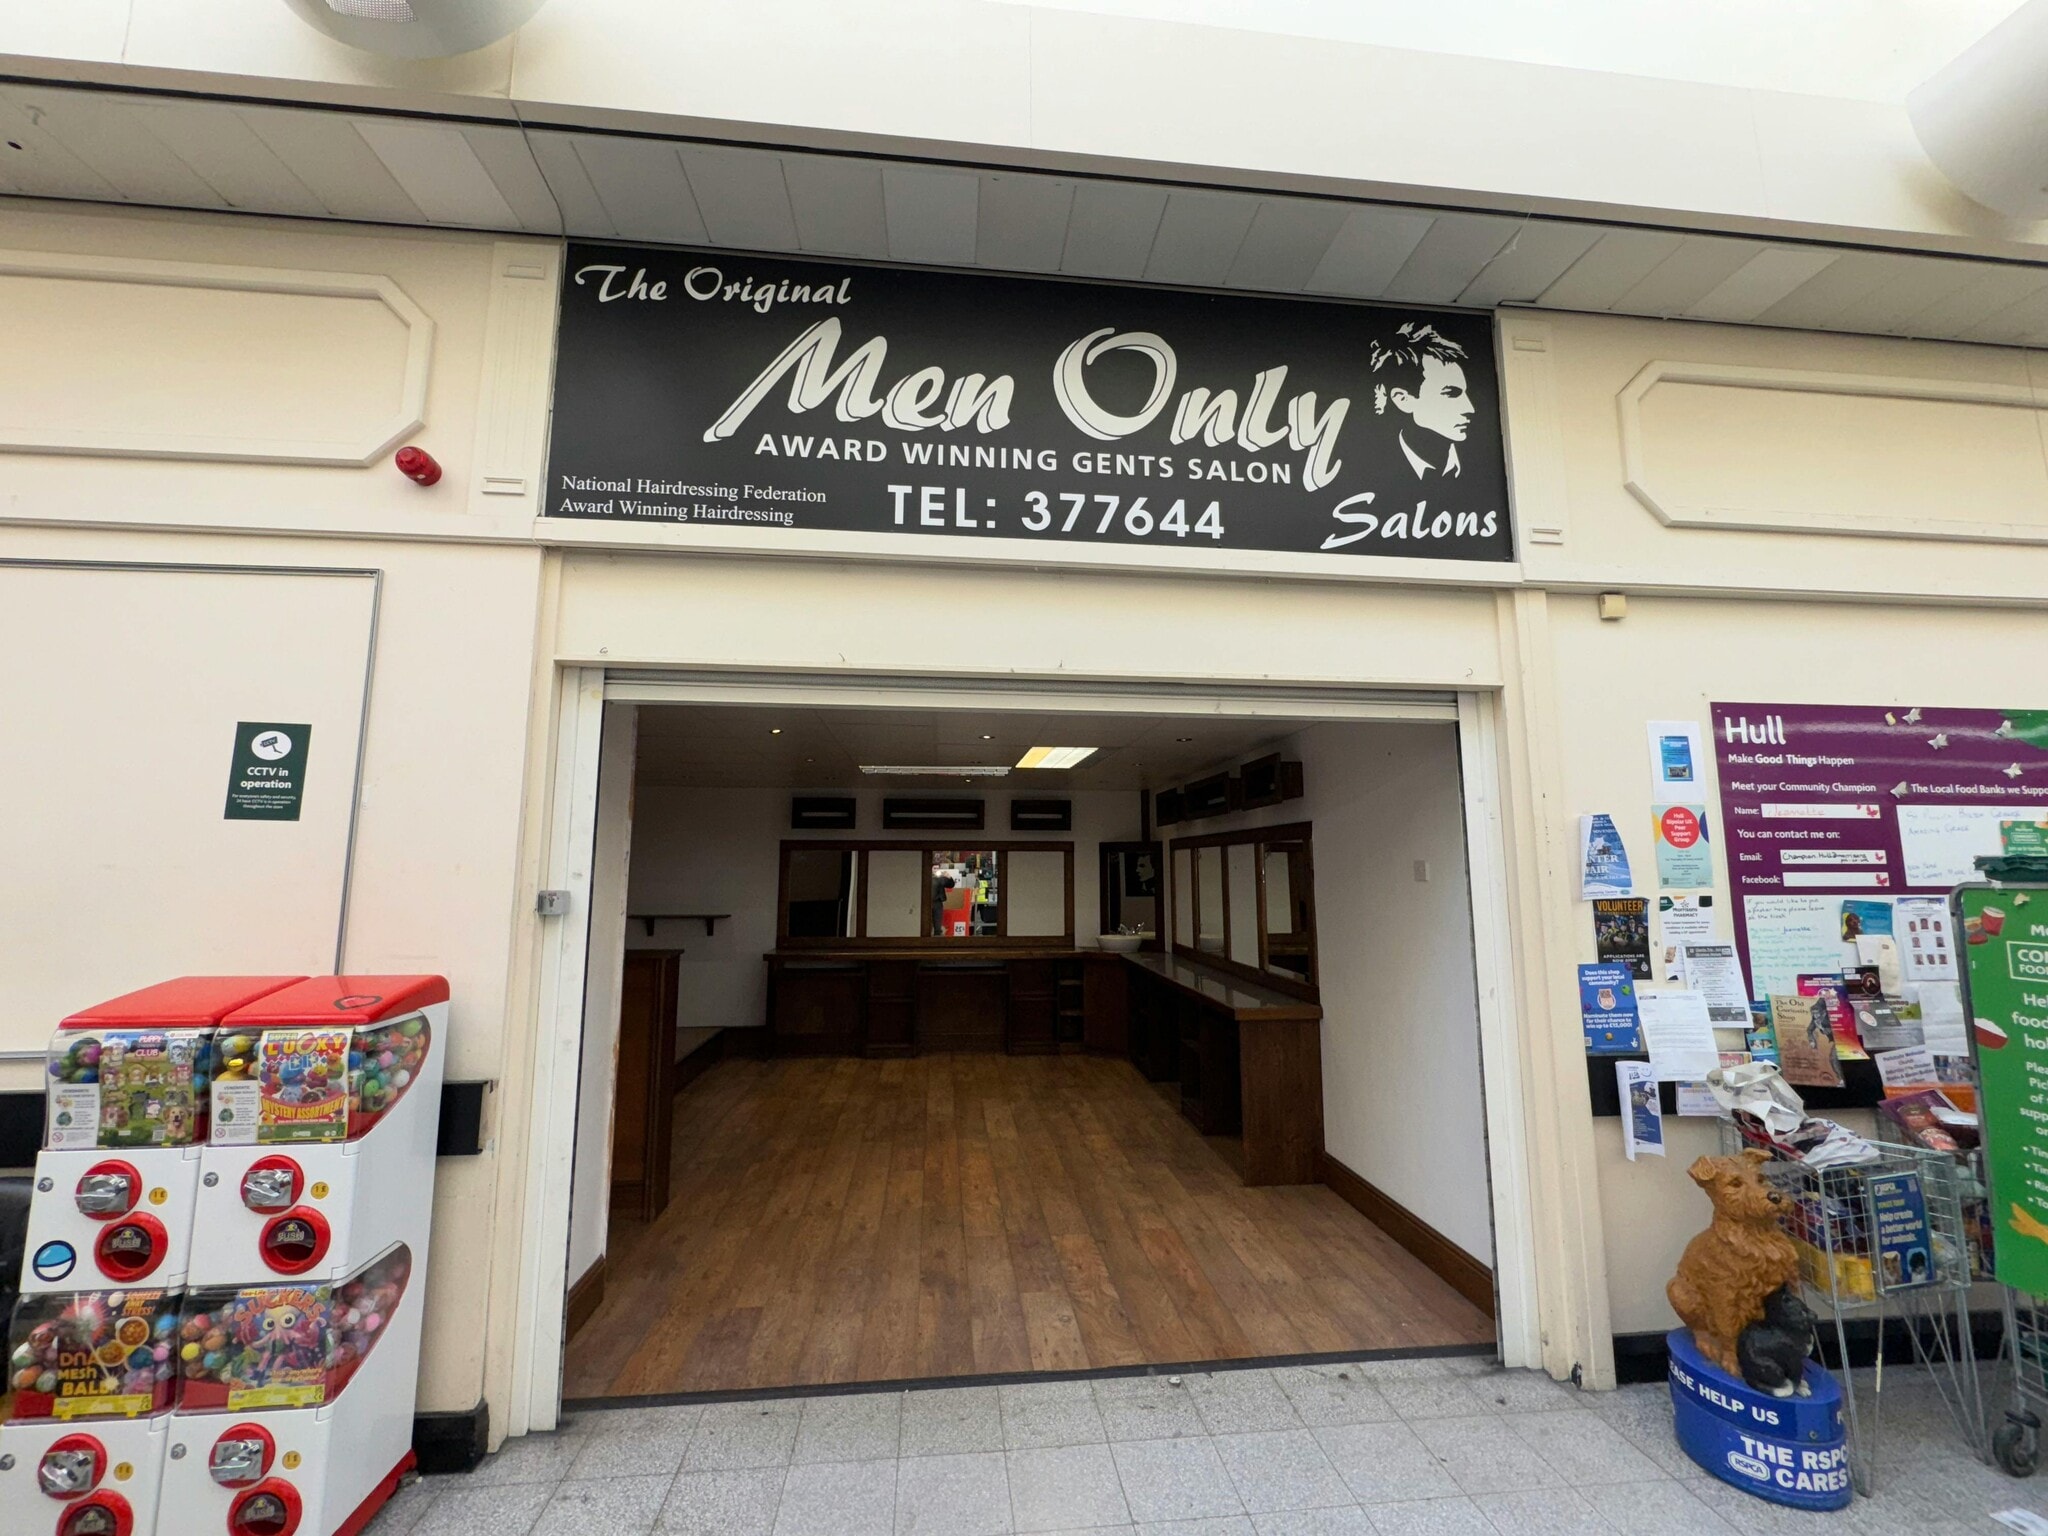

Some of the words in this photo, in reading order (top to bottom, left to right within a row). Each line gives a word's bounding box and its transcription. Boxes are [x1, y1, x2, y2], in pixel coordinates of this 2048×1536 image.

[575, 264, 668, 303] The
[684, 266, 851, 313] Original
[703, 316, 1014, 443] Men
[1053, 327, 1350, 492] Only
[755, 434, 888, 463] AWARD
[902, 441, 1058, 471] WINNING
[1072, 451, 1174, 478] GENTS
[1188, 458, 1292, 484] SALON
[562, 476, 632, 493] National
[637, 478, 739, 502] Hairdressing
[743, 484, 827, 503] Federation
[560, 498, 613, 515] Award
[619, 500, 688, 520] Winning
[693, 504, 794, 526] Hairdressing
[887, 484, 996, 529] TEL:
[1021, 490, 1225, 539] 377644
[1320, 492, 1498, 550] Salons
[1724, 716, 1786, 745] Hull
[1728, 754, 1754, 764] Make
[1755, 754, 1782, 764] Good
[1786, 754, 1817, 767] Things
[1819, 756, 1854, 769] Happen
[246, 766, 276, 776] CCTV
[278, 768, 288, 776] in
[240, 780, 292, 790] operation
[1732, 782, 1755, 792] Meet
[1757, 784, 1777, 795] your
[1779, 782, 1829, 795] Community
[1832, 782, 1876, 795] Champion
[1911, 784, 1928, 794] The
[1930, 784, 1954, 794] Local
[1956, 784, 1978, 794] Food
[1980, 784, 2006, 795] Banks
[2007, 786, 2020, 795] we
[1734, 806, 1759, 816] Name:
[1737, 829, 1754, 838] You
[1774, 830, 1808, 840] contact
[1810, 832, 1824, 840] me
[1826, 832, 1840, 840] on:
[1740, 852, 1763, 862] Email:
[1742, 874, 1781, 885] Facebook:
[1596, 900, 1643, 912] VOLUNTEER
[2018, 949, 2048, 963] CO
[2019, 964, 2048, 976] FOO
[139, 1035, 162, 1043] PUPPY
[2030, 1094, 2045, 1104] of
[262, 1099, 298, 1118] MYSTERY
[234, 1290, 326, 1322] SUCKERS
[1699, 1384, 1745, 1413] HELP
[1752, 1406, 1780, 1425] US
[1740, 1436, 1795, 1467] THE
[1734, 1458, 1763, 1474] RSPCA
[1776, 1468, 1848, 1492] CARES
